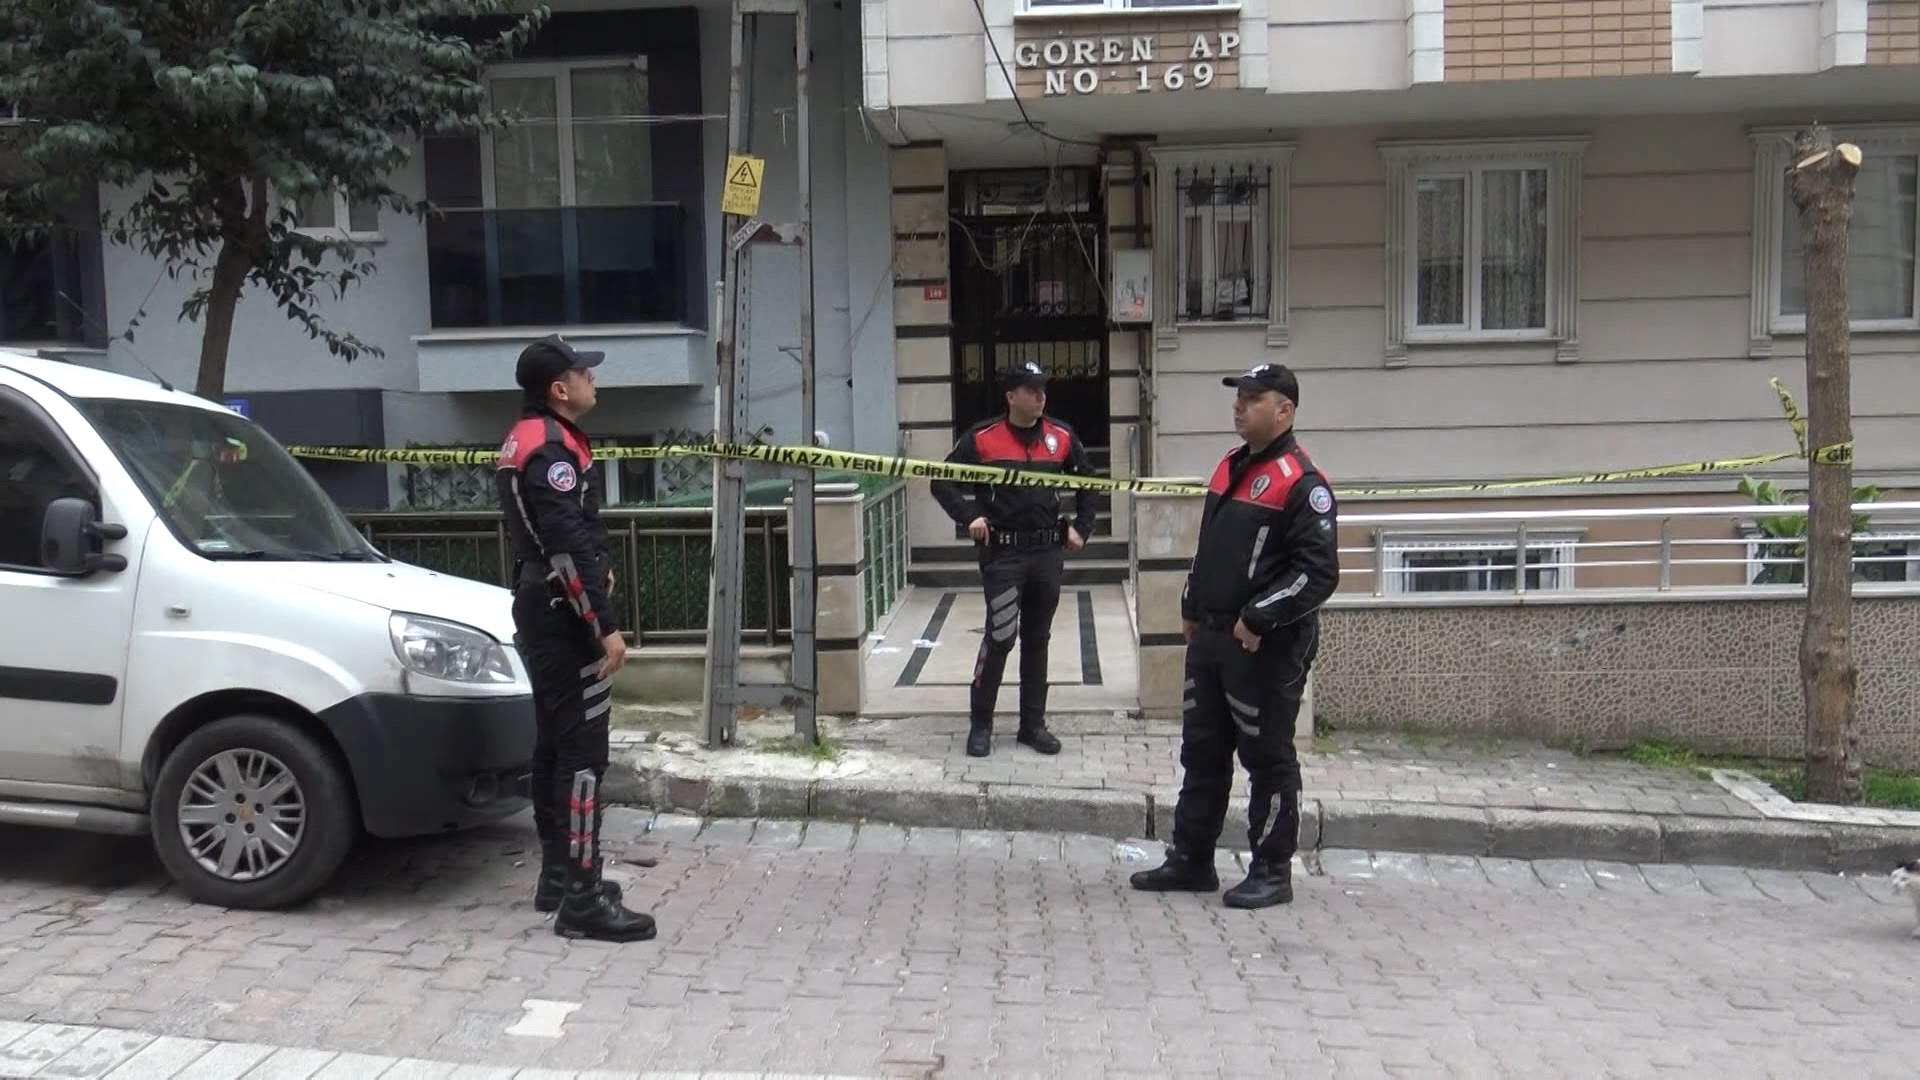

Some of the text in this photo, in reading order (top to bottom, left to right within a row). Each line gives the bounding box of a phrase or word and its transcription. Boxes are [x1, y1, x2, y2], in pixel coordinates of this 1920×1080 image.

[1189, 32, 1240, 59] AP
[1136, 63, 1214, 92] 169
[782, 449, 835, 468] KAZA
